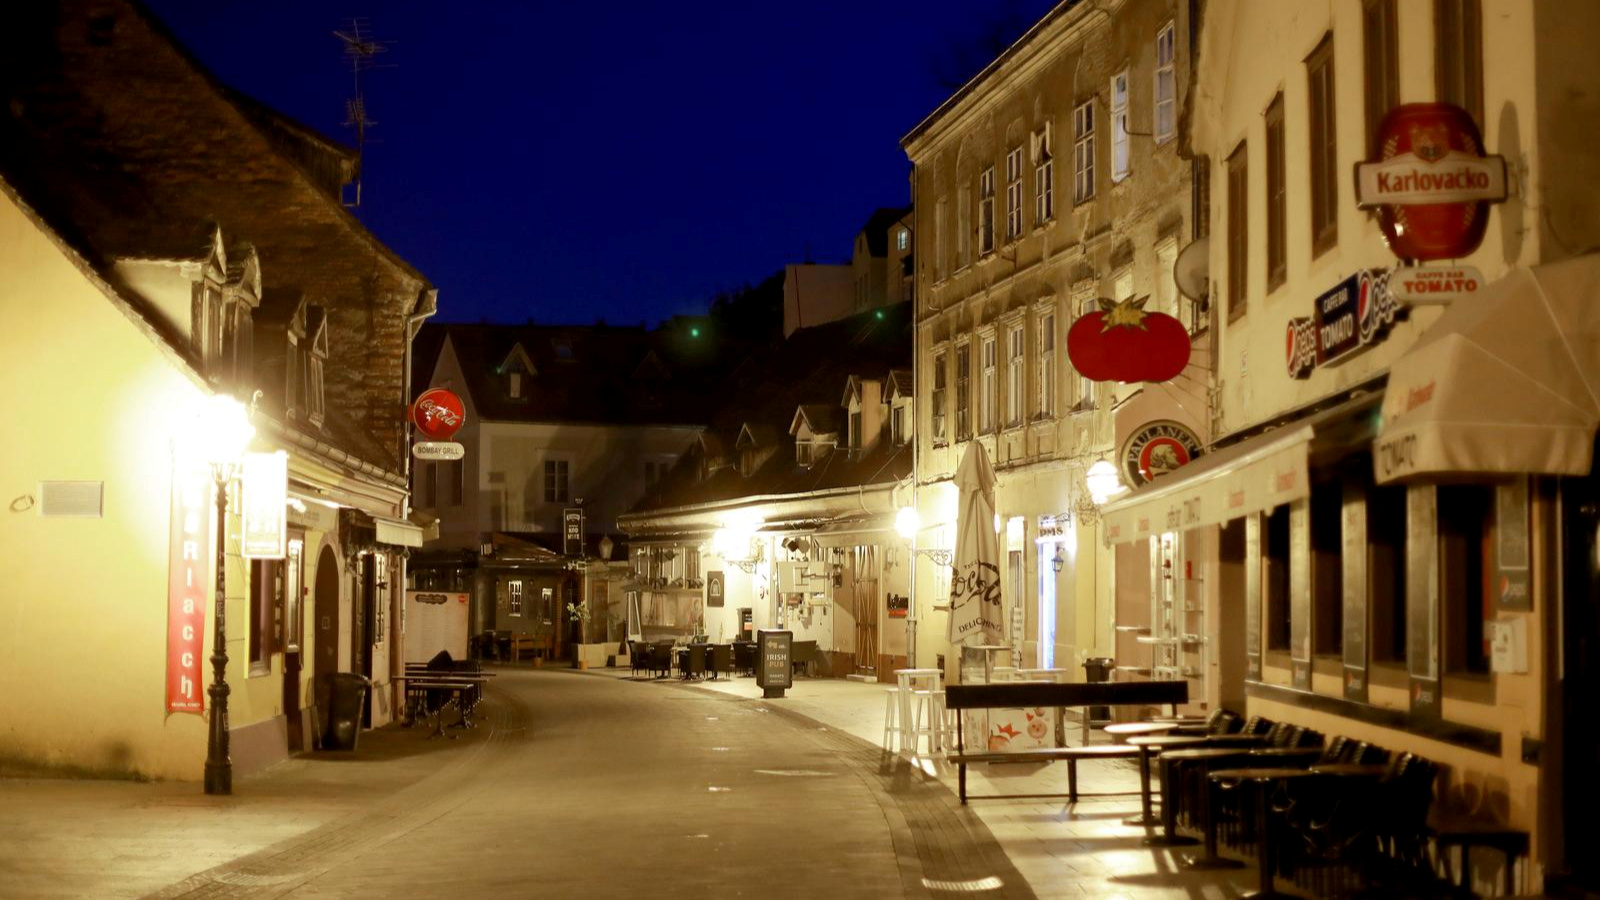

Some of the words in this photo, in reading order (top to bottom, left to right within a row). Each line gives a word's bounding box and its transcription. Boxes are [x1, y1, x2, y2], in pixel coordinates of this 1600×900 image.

[1403, 279, 1478, 294] TOMATO
[1320, 312, 1353, 350] TOMATO
[417, 446, 442, 454] BOMBAY
[442, 447, 459, 455] GRILL
[1128, 426, 1196, 462] PAULANER
[766, 653, 787, 661] IRISH
